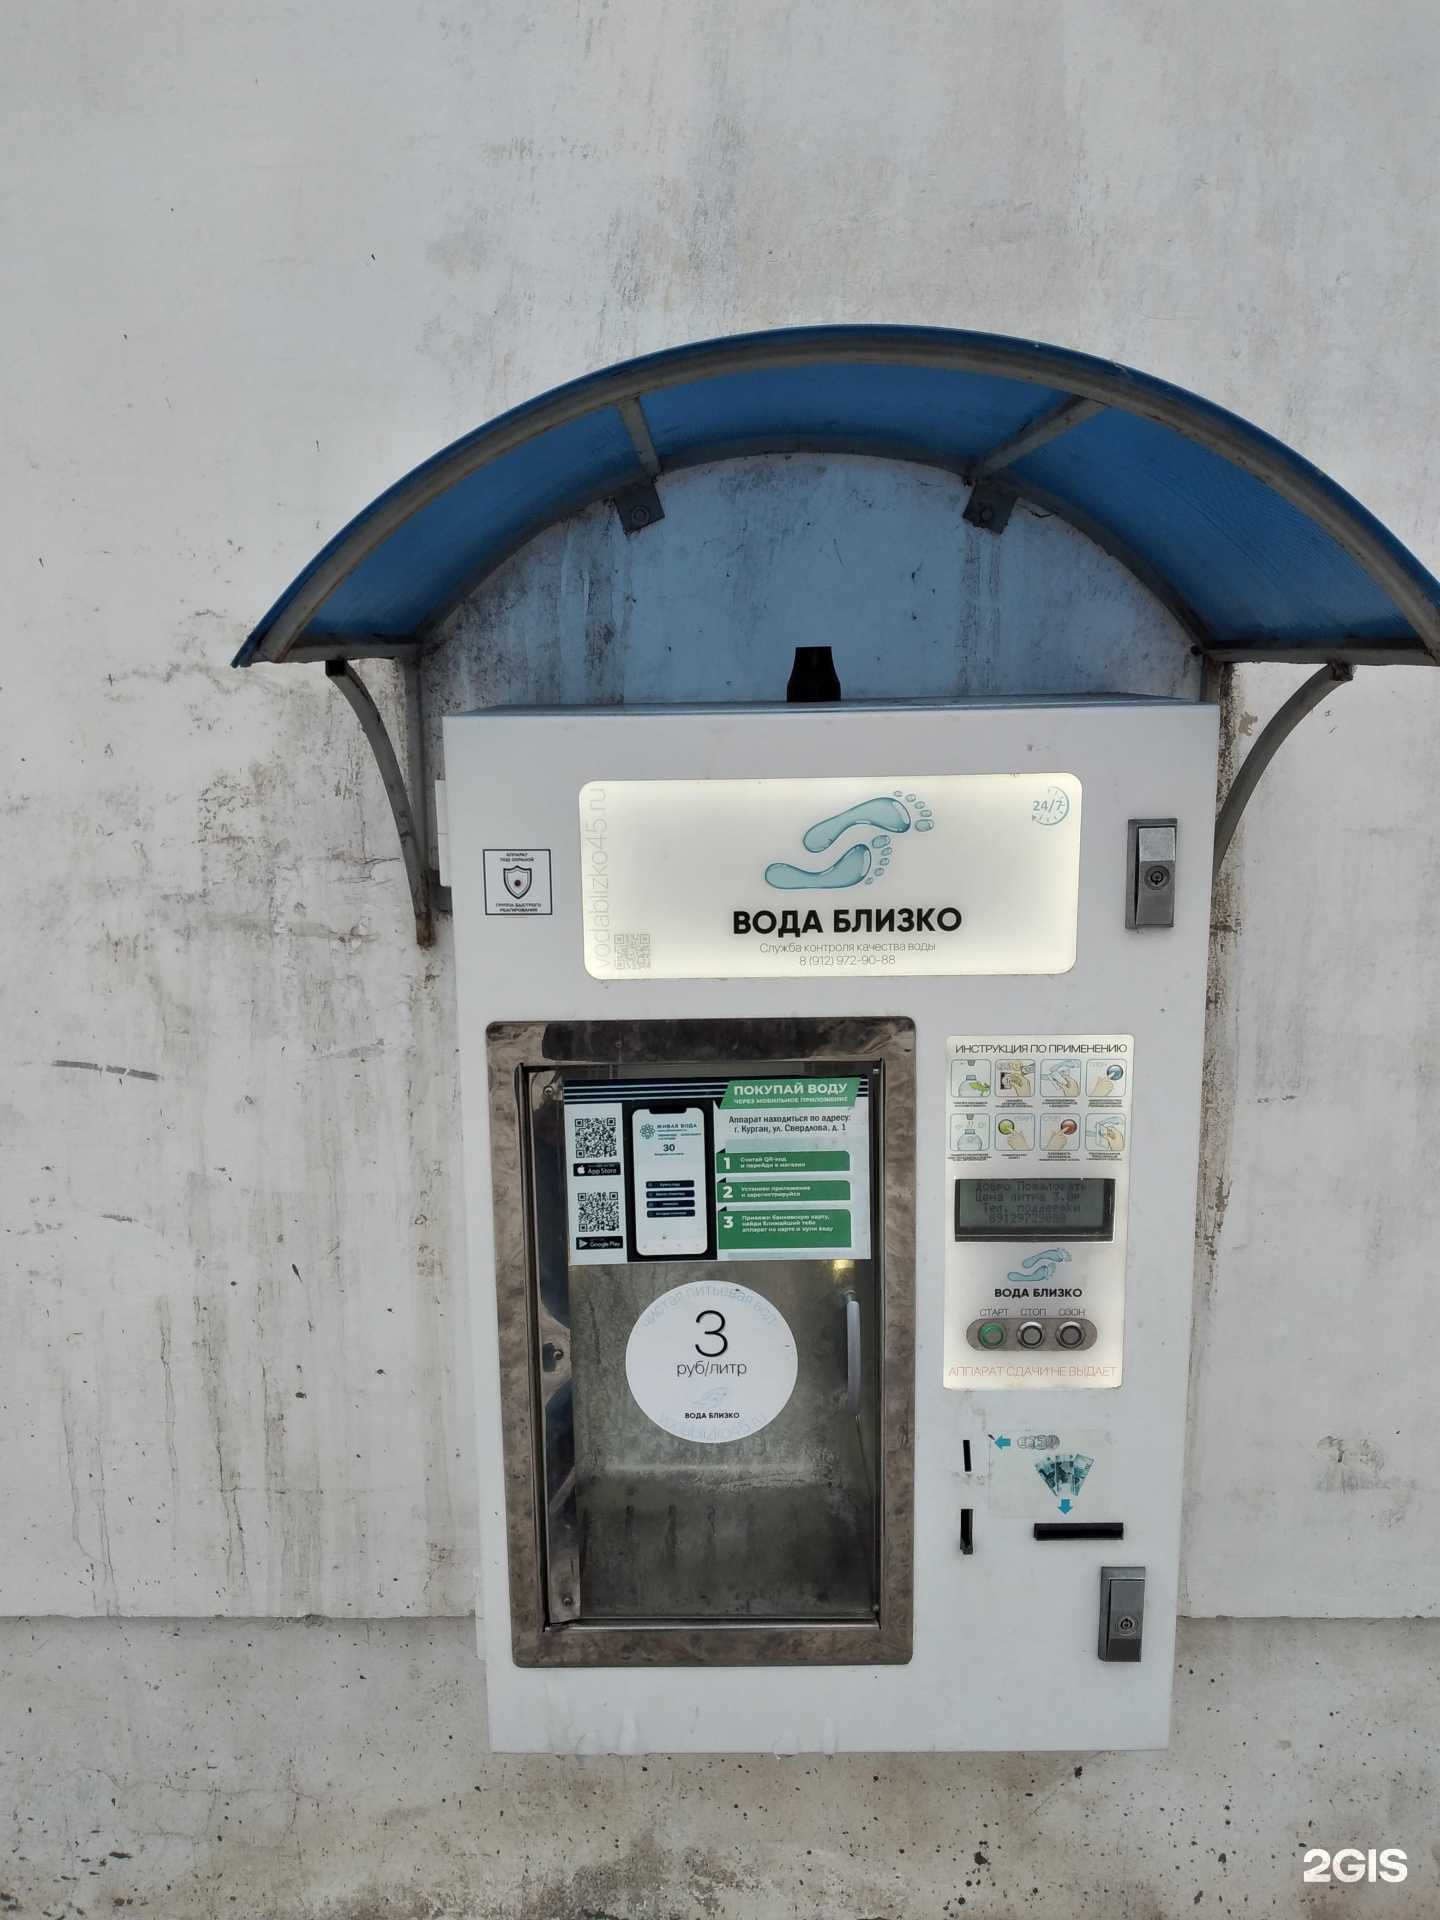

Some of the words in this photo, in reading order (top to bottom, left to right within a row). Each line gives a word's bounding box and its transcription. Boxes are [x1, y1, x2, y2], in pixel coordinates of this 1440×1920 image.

[1032, 799, 1063, 813] 24/7
[585, 787, 611, 970] vodablizko45.ru
[732, 909, 824, 938] ВОДА
[833, 906, 963, 934] БЛИЗКО
[759, 942, 802, 954] Служба
[803, 942, 855, 954] контроля
[856, 941, 906, 952] качества
[907, 941, 936, 953] воды
[799, 956, 807, 966] 8
[809, 955, 834, 967] (912)
[836, 954, 896, 966] 972-90-88
[955, 1044, 1029, 1055] ИНСТРУКЦИЯ
[1030, 1044, 1047, 1054] ПО
[1049, 1043, 1128, 1054] ПРИМЕНЕНИЮ
[733, 1082, 804, 1096] ПОКУПАЙ
[807, 1082, 848, 1096] ВОДУ
[729, 1115, 762, 1125] Аппарат
[764, 1115, 808, 1124] находиться
[741, 1125, 771, 1134] Курган,
[773, 1126, 782, 1134] ул.
[841, 1123, 846, 1131] 1
[663, 1143, 676, 1152] 30
[723, 1156, 731, 1170] 1
[722, 1185, 733, 1199] 2
[723, 1215, 734, 1229] 3
[588, 1241, 609, 1249] Google
[994, 1288, 1030, 1299] ВОДА
[1032, 1287, 1083, 1298] БЛИЗКО
[979, 1308, 1009, 1317] СТАРТ
[1020, 1308, 1047, 1317] СТОП
[1058, 1308, 1086, 1317] ОЗОН
[694, 1309, 729, 1358] 3
[676, 1360, 748, 1377] руб/литр
[949, 1365, 1004, 1377] АППАРАТ
[1006, 1365, 1049, 1378] СДАЧИ
[1051, 1366, 1067, 1377] НЕ
[1068, 1365, 1118, 1378] ВЫДАЕТ
[684, 1411, 707, 1420] ВОДА
[708, 1411, 741, 1420] БЛИЗКО
